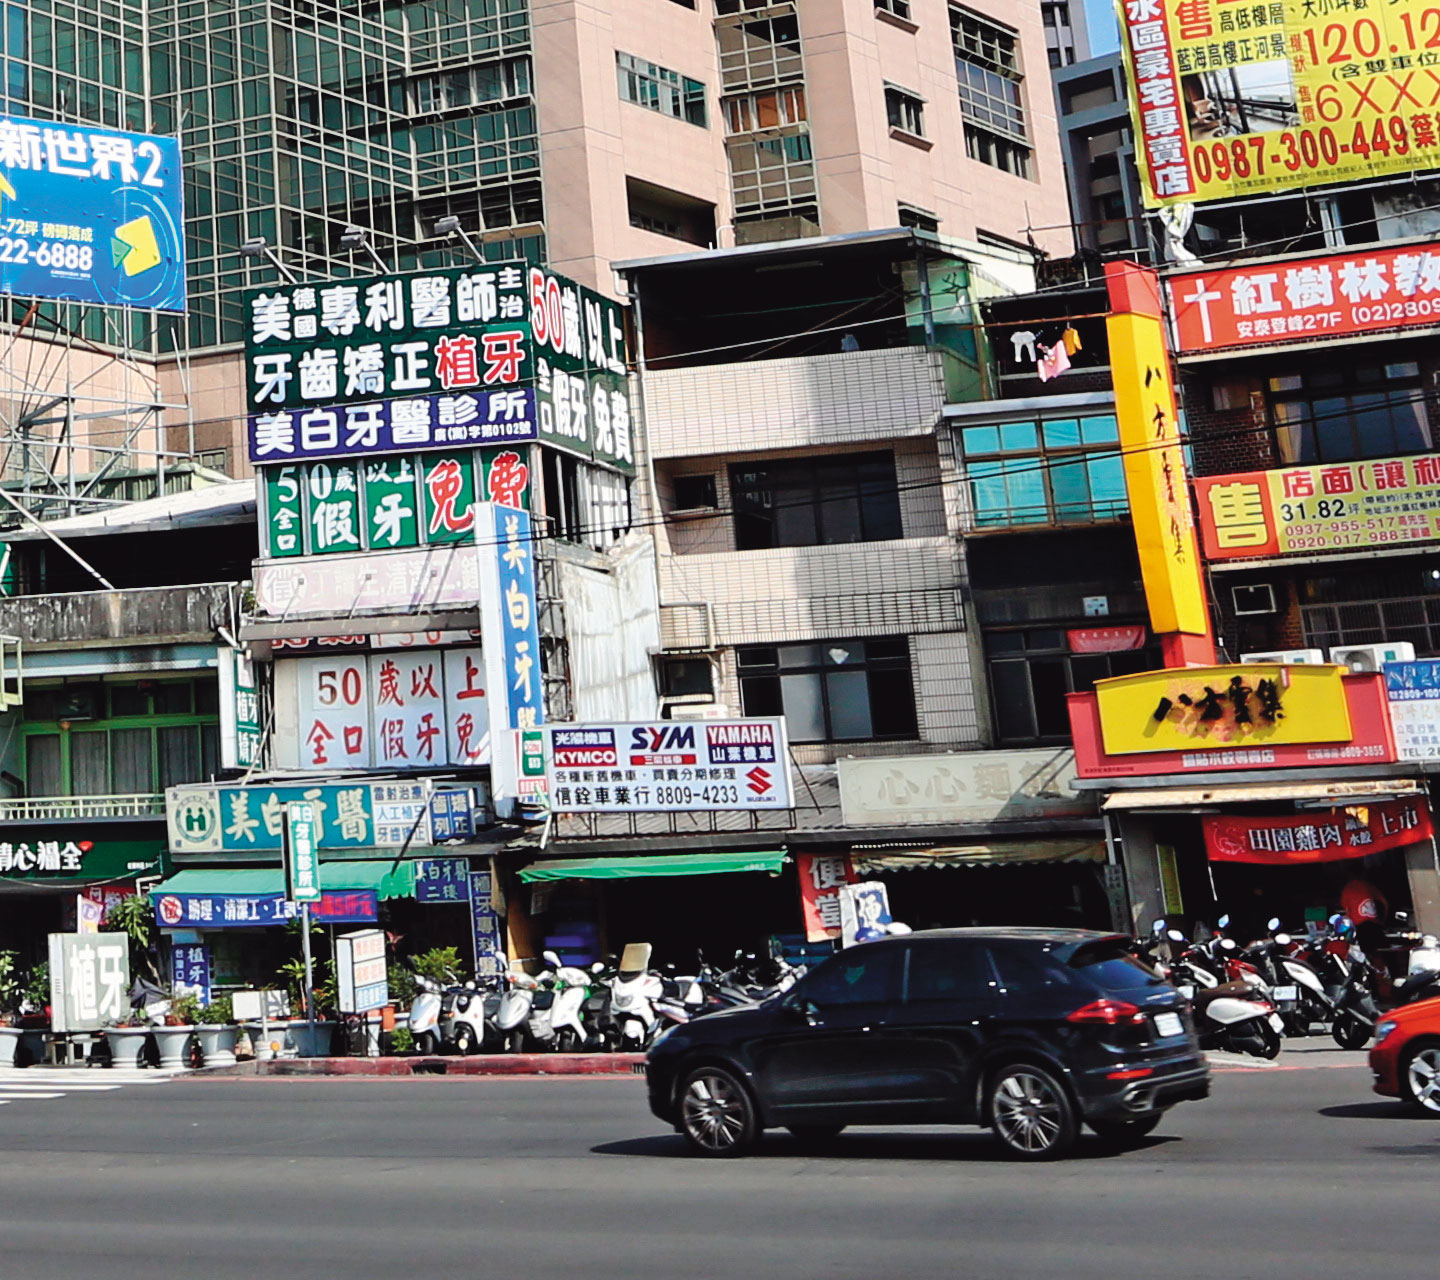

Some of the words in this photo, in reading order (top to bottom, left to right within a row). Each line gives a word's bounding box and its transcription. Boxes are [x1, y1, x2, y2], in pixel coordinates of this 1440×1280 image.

[1177, 34, 1288, 71] 藍海高樓正河景
[1298, 85, 1316, 123] 售價
[1193, 115, 1409, 184] 0987-300-449
[529, 267, 626, 376] 50歲以上
[1237, 310, 1342, 339] 安泰登峰27F
[252, 330, 526, 404] 牙齒矯正植牙
[255, 391, 526, 457] 美白牙醫診所
[426, 452, 528, 534] 免費
[1209, 482, 1268, 548] 售
[1285, 518, 1395, 536] 0937-955-517
[1287, 530, 1398, 549] 0920-017-988
[317, 655, 486, 707] 50歲以上
[554, 750, 616, 765] KYMCO
[711, 746, 773, 762] 山葉機車
[631, 726, 696, 753] SYM
[708, 726, 772, 744] YAMAHA
[555, 786, 651, 806] 信銓車業行
[656, 785, 738, 804] 8809-4233
[1248, 824, 1342, 852] 田園雞肉
[69, 943, 126, 1022] 植牙
